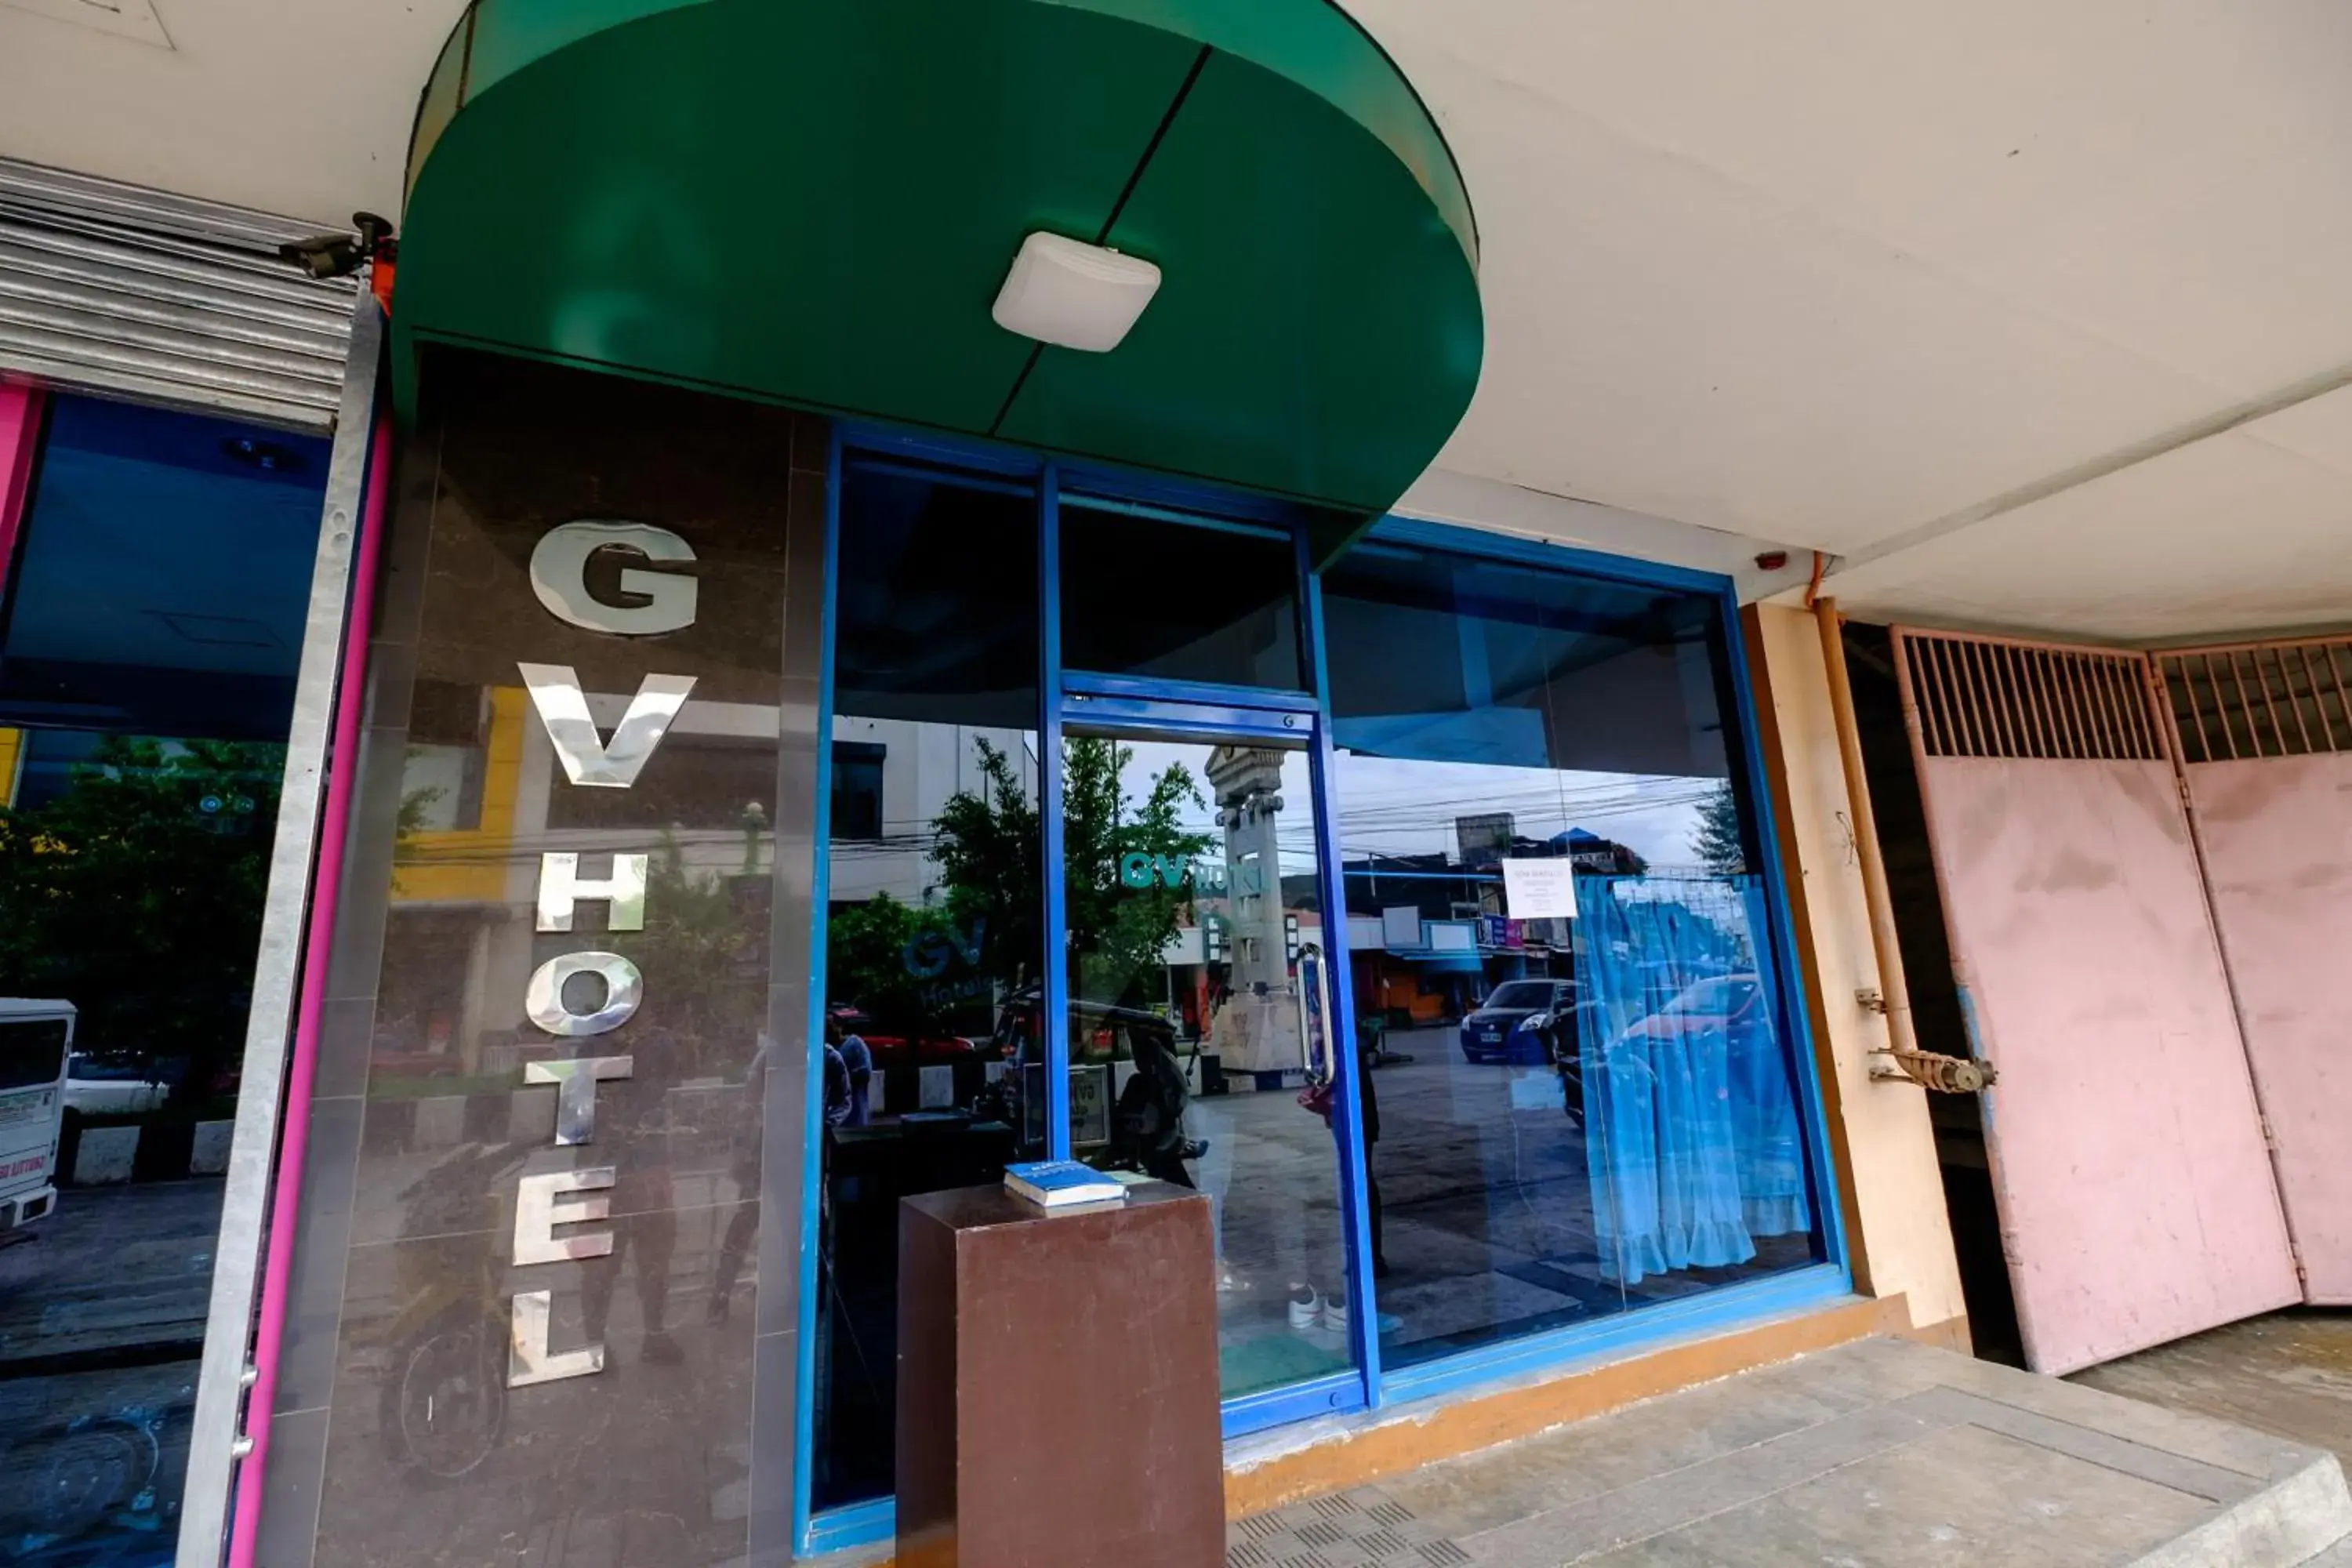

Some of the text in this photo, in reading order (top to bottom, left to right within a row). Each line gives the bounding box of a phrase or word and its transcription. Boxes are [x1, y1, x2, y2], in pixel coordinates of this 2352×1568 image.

[1120, 851, 1187, 889] GV
[506, 519, 699, 1388] GV HOTEL
[902, 913, 988, 978] GV
